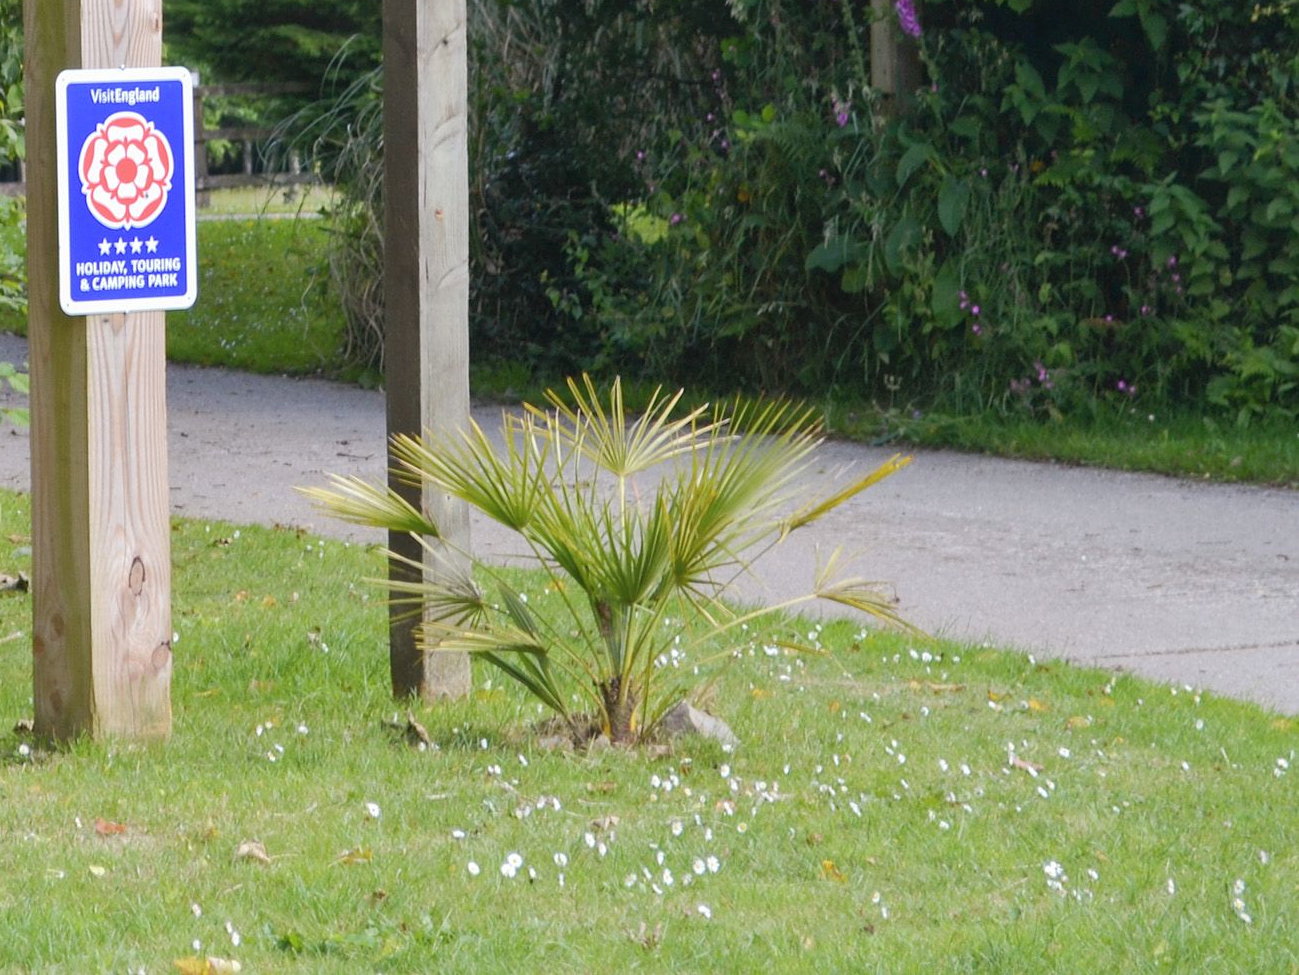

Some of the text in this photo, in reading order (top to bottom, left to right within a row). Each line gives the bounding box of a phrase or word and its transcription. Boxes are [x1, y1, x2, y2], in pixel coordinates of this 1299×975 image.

[90, 86, 160, 106] VisitEngland
[76, 257, 182, 277] HOLIDAY, TOURING
[80, 272, 178, 292] & CAMPING PARK
